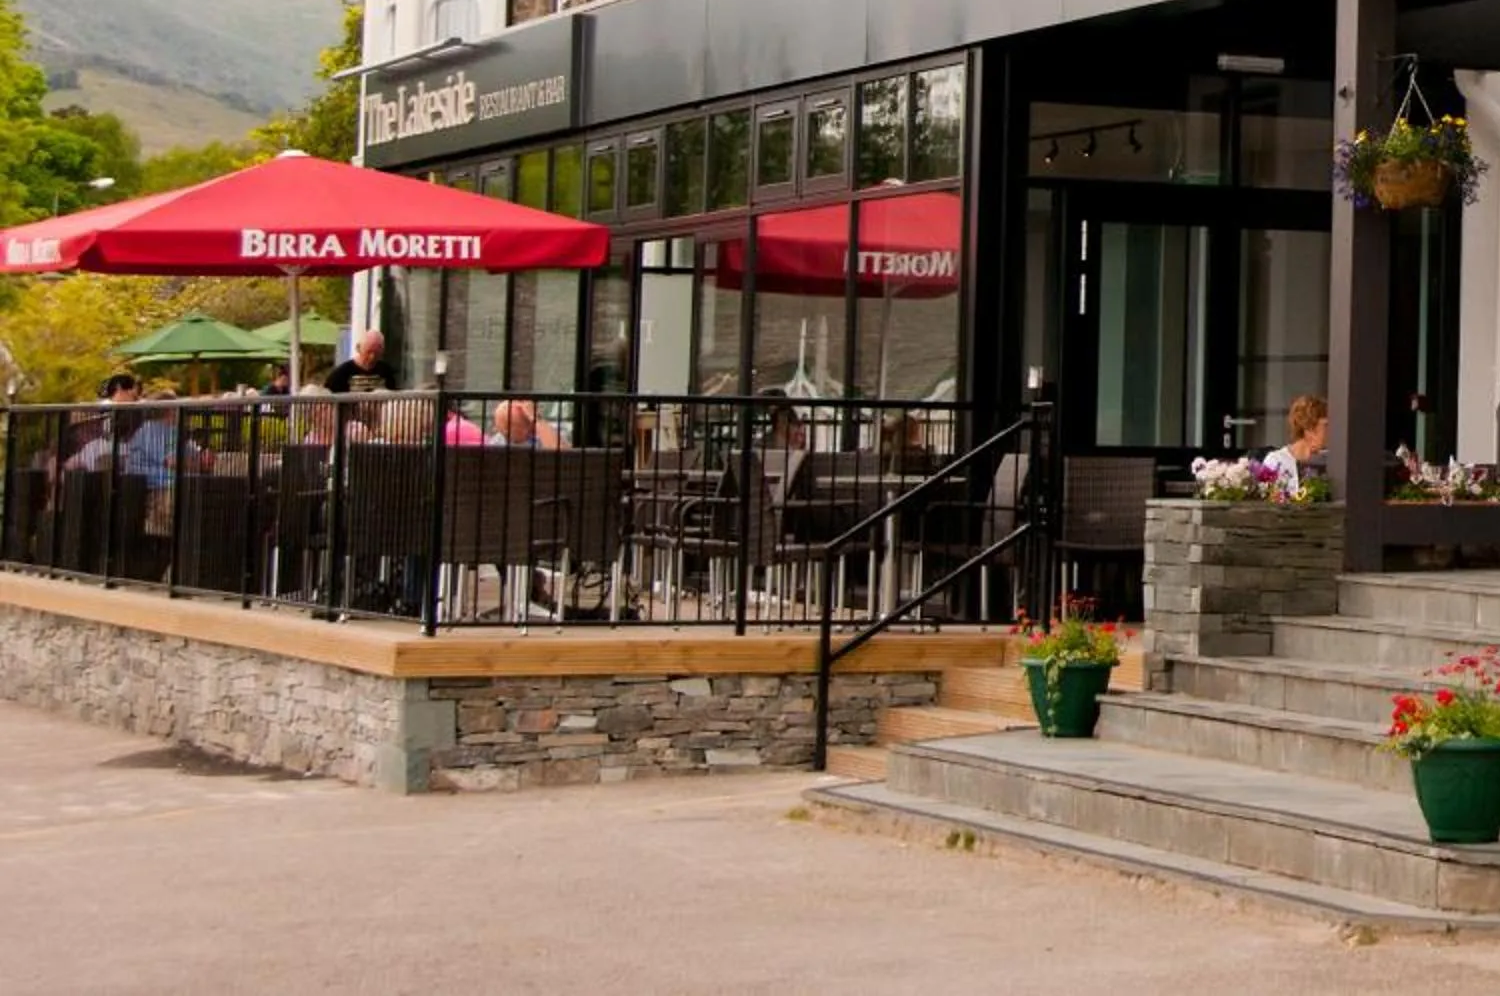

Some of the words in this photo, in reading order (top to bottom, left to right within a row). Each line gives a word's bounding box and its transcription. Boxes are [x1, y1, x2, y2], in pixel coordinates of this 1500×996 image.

[365, 91, 398, 146] The
[397, 70, 476, 139] Lakeside
[479, 83, 538, 121] RESTAURANT
[240, 228, 347, 258] BIRRA
[358, 229, 482, 259] MORETTI
